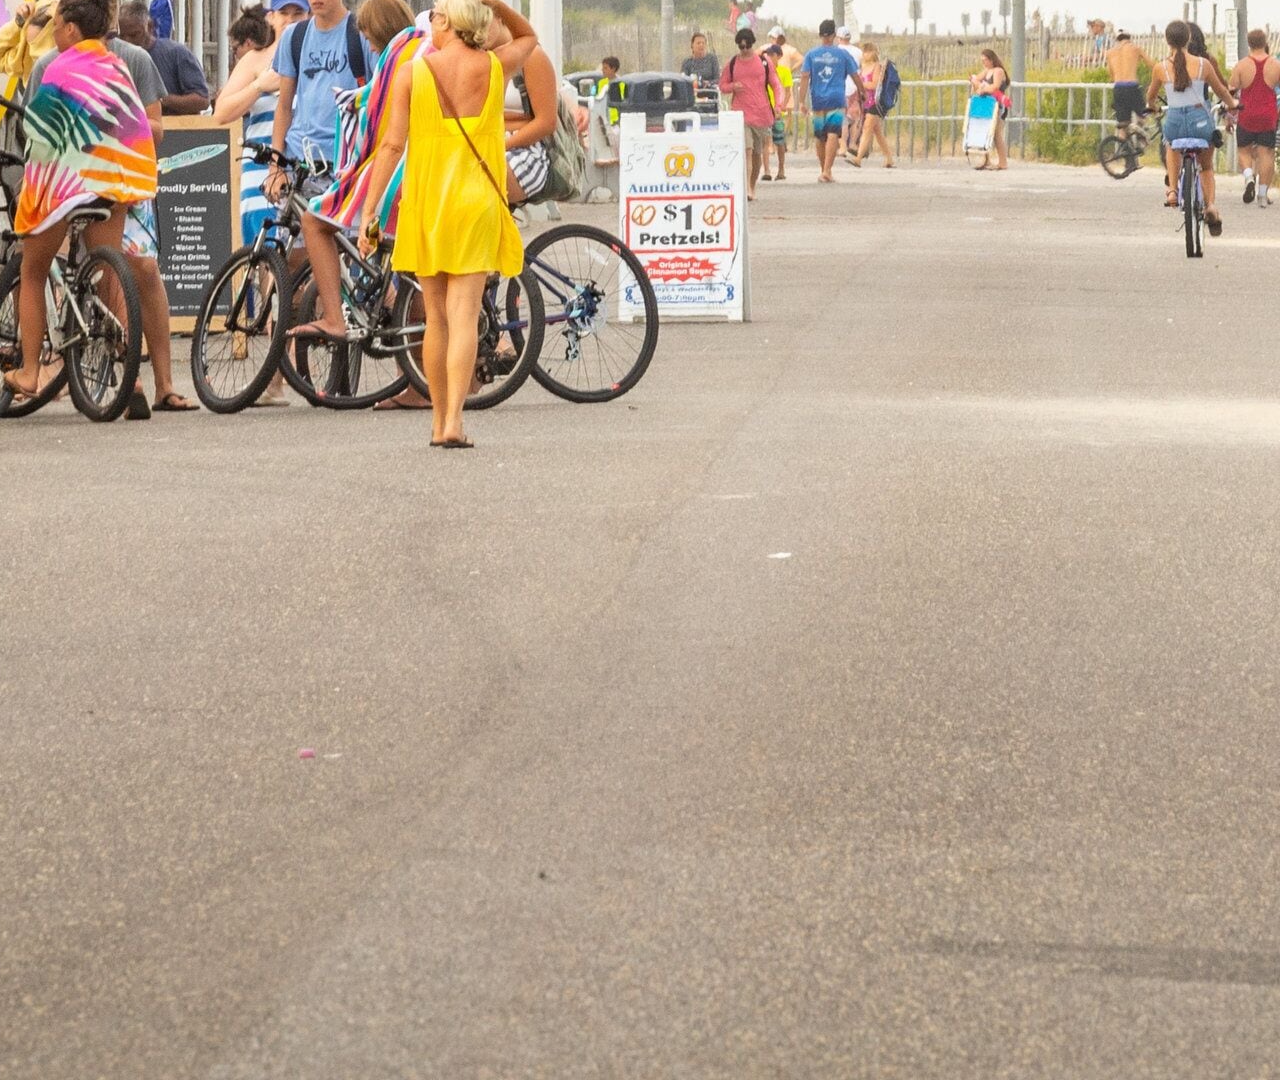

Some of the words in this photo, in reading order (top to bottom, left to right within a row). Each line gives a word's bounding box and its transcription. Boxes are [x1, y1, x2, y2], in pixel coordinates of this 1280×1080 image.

[156, 183, 189, 195] roudly
[190, 182, 228, 194] Serving
[629, 182, 680, 193] Auntie
[681, 182, 731, 192] Anne's
[663, 204, 693, 230] $1
[639, 231, 720, 245] Pretzels!
[659, 261, 691, 270] Original
